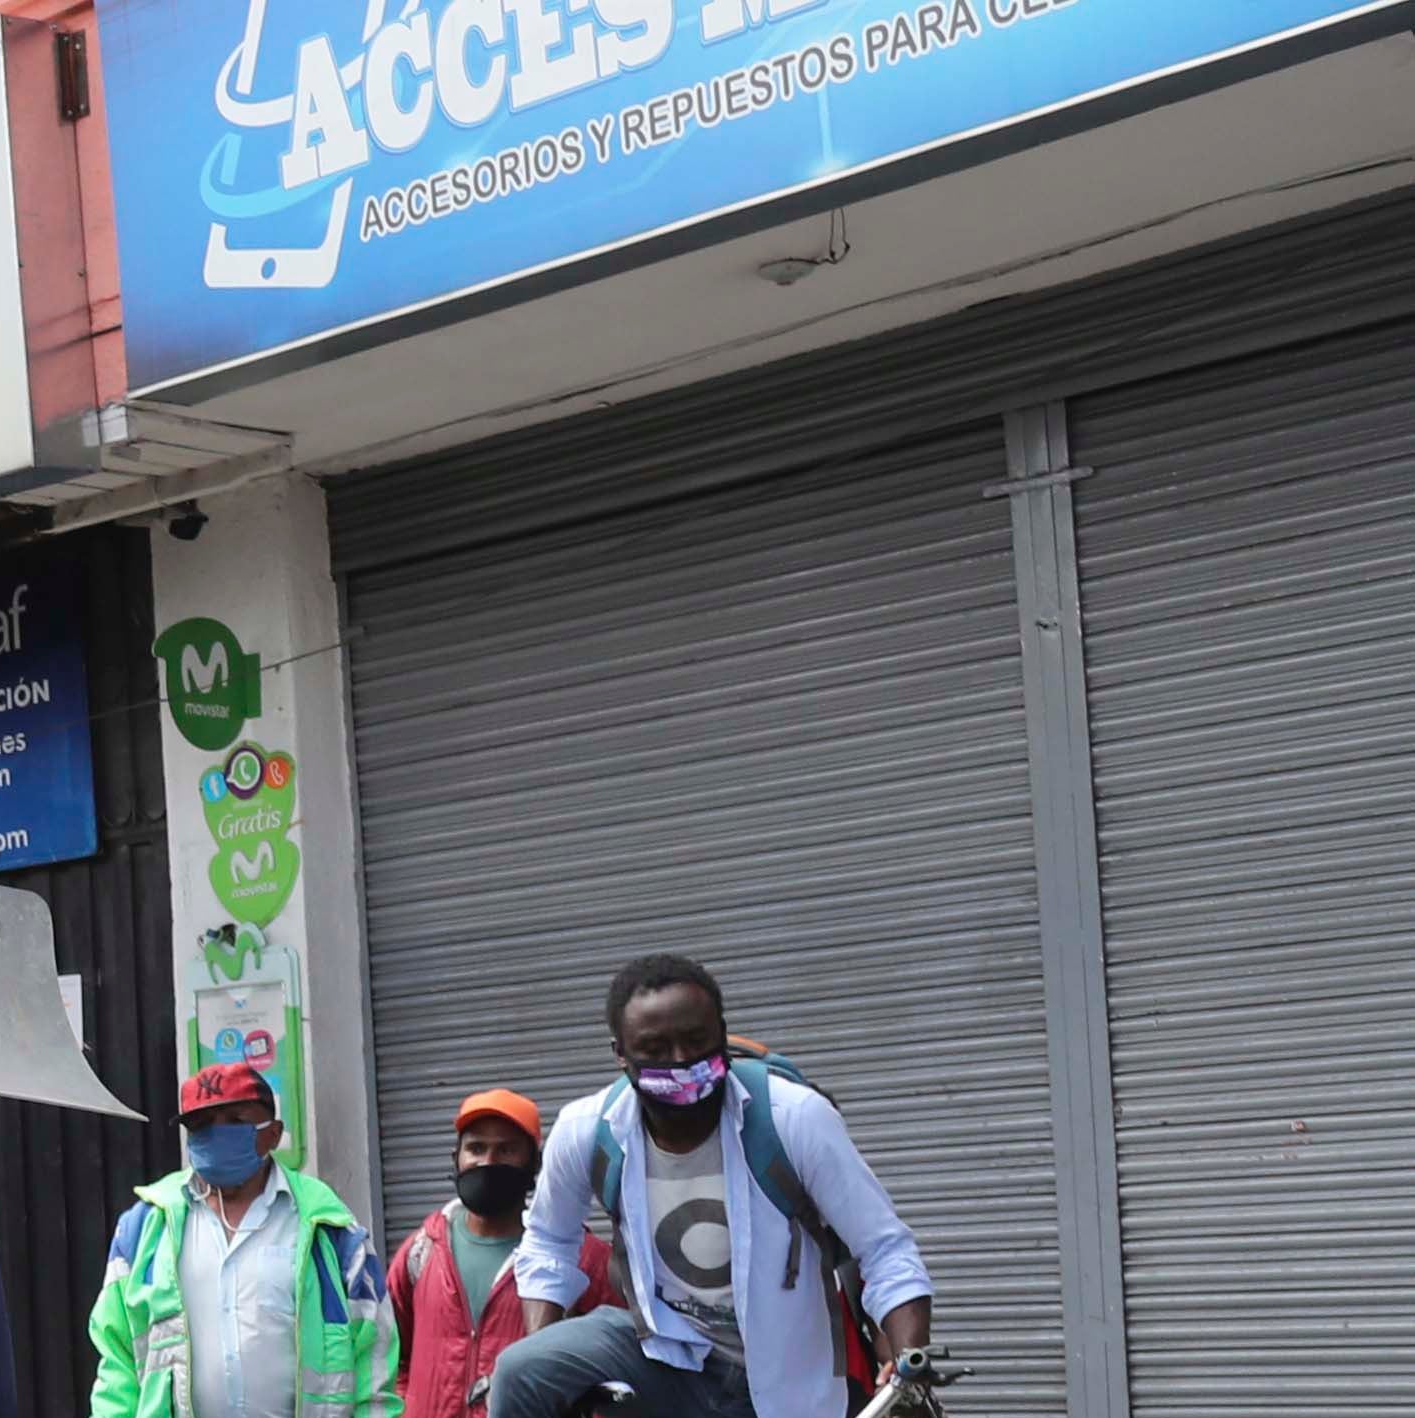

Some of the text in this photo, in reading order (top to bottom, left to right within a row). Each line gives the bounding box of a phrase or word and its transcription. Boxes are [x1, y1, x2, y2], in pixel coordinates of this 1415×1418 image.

[361, 128, 584, 239] ACCESORIOS
[589, 116, 612, 160] Y
[622, 36, 855, 151] REPUESTOS
[865, 0, 978, 69] PARA
[183, 702, 231, 719] movistar
[218, 804, 282, 840] Gratis
[232, 881, 278, 898] movistar
